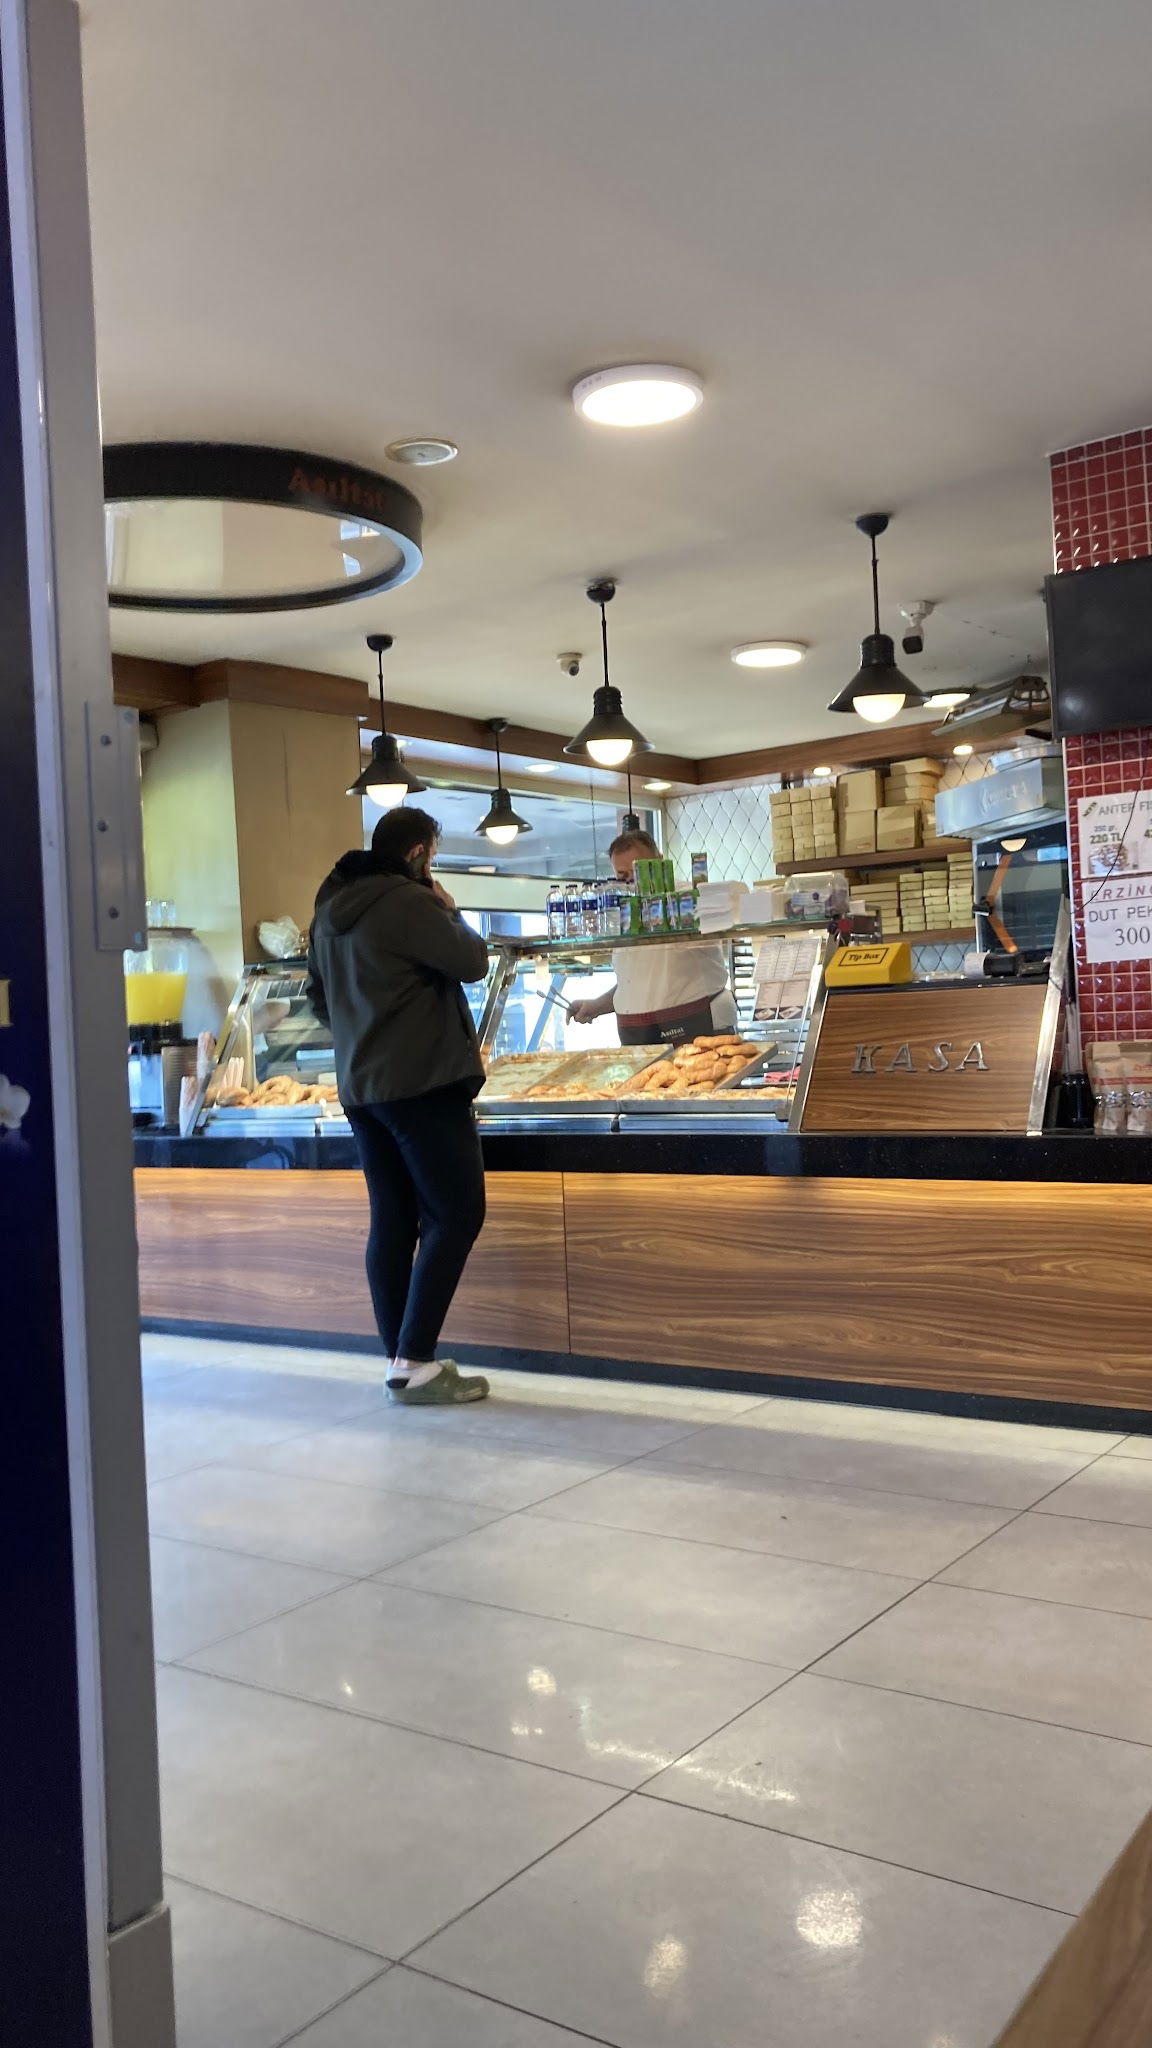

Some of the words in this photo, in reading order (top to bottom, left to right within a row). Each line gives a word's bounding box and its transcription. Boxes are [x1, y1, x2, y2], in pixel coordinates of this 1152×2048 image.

[1090, 834, 1108, 844] 220
[1110, 833, 1122, 841] TL
[1091, 884, 1152, 900] RZİN
[1089, 908, 1118, 922] DUT
[1115, 926, 1151, 946] 300
[848, 954, 862, 962] Tip
[851, 1042, 990, 1073] KASA
